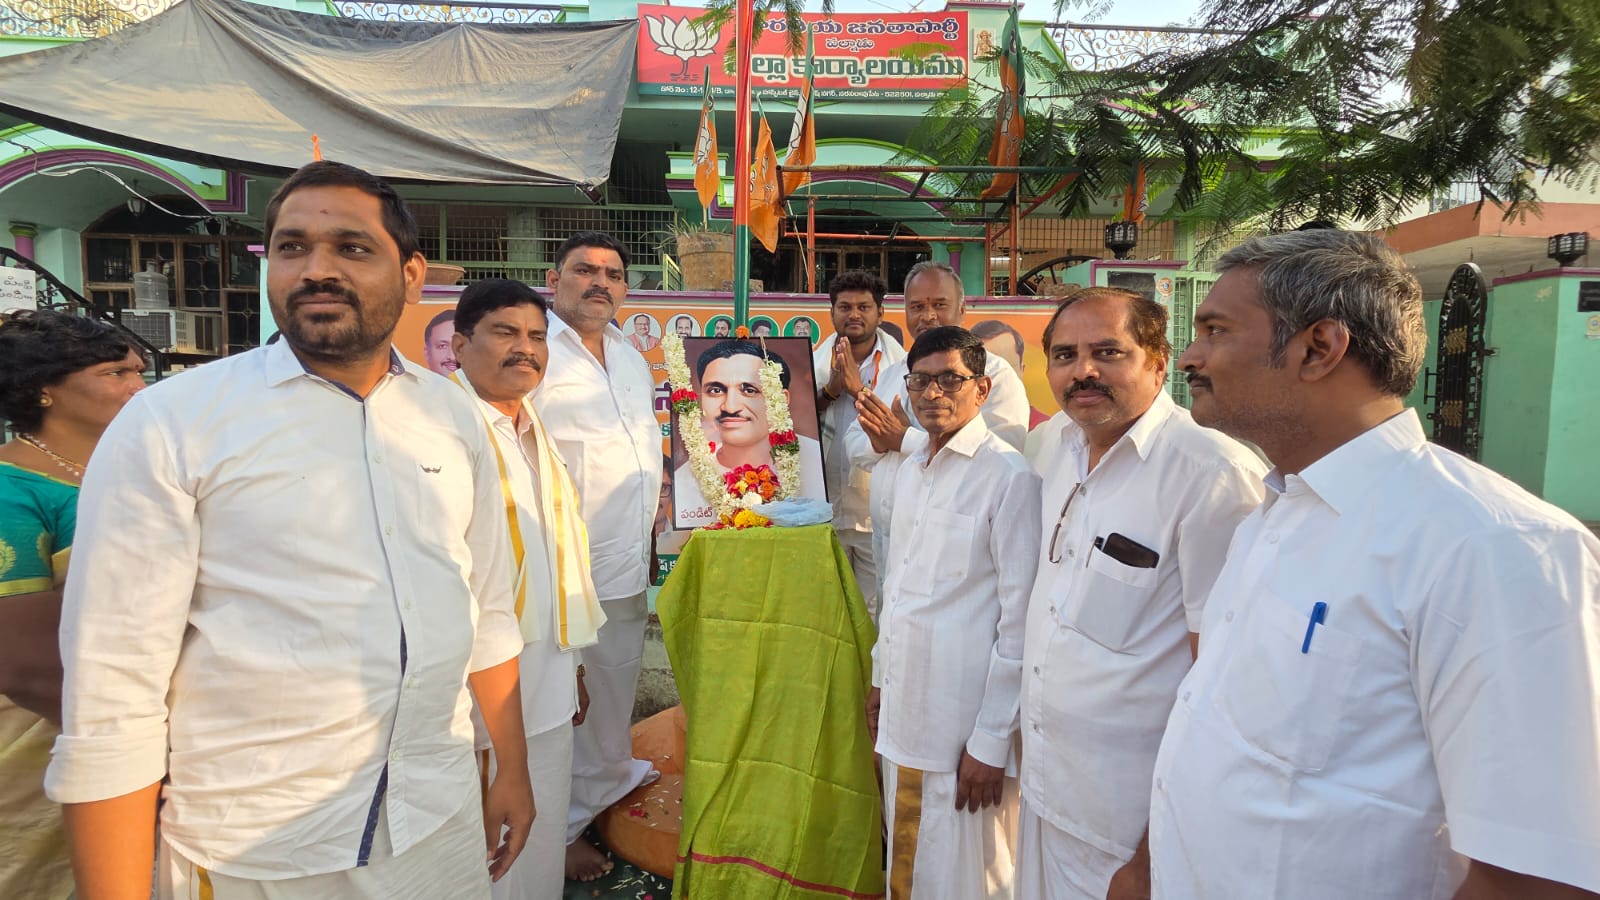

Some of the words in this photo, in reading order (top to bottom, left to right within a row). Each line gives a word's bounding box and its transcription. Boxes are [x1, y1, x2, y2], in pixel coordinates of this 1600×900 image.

[848, 18, 959, 40] జనతాపార్టీ
[826, 38, 874, 52] పల్నాడు
[680, 505, 713, 519] పండిట్
